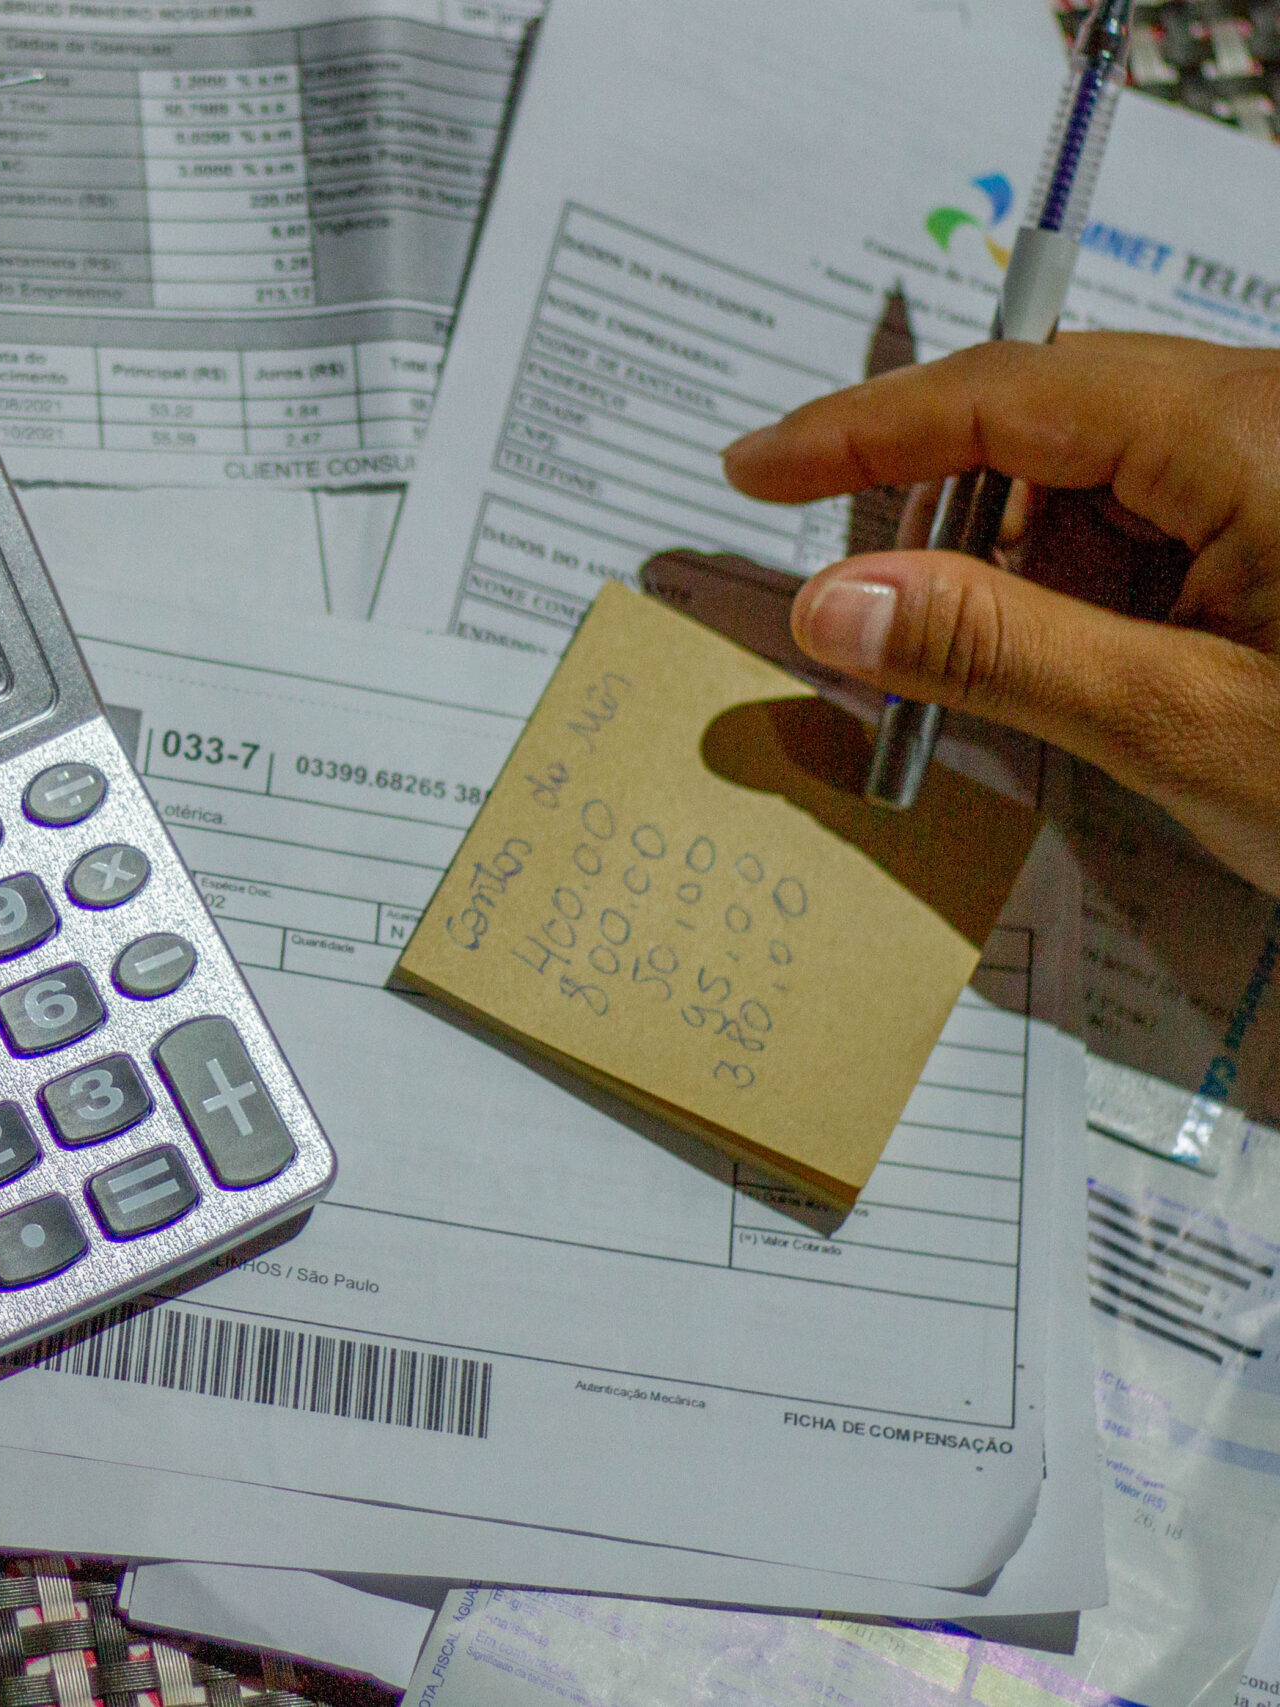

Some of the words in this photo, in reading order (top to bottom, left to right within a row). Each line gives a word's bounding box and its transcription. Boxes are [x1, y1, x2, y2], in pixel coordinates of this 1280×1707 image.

[224, 459, 321, 480] CLIENTE
[532, 595, 587, 622] COM
[160, 729, 261, 770] 033-7
[295, 755, 448, 800] 03399.68265
[291, 933, 356, 955] Quantidade
[391, 925, 405, 940] N
[23, 978, 79, 1030] 6
[67, 1067, 125, 1121] 3
[296, 1267, 329, 1286] São
[333, 1272, 380, 1295] Paulo
[574, 1379, 648, 1402] Autenticação
[649, 1390, 707, 1410] Mecânica
[782, 1410, 837, 1434] FICHA
[841, 1419, 867, 1437] DE
[868, 1423, 1015, 1456] COMPENSAÇÃO
